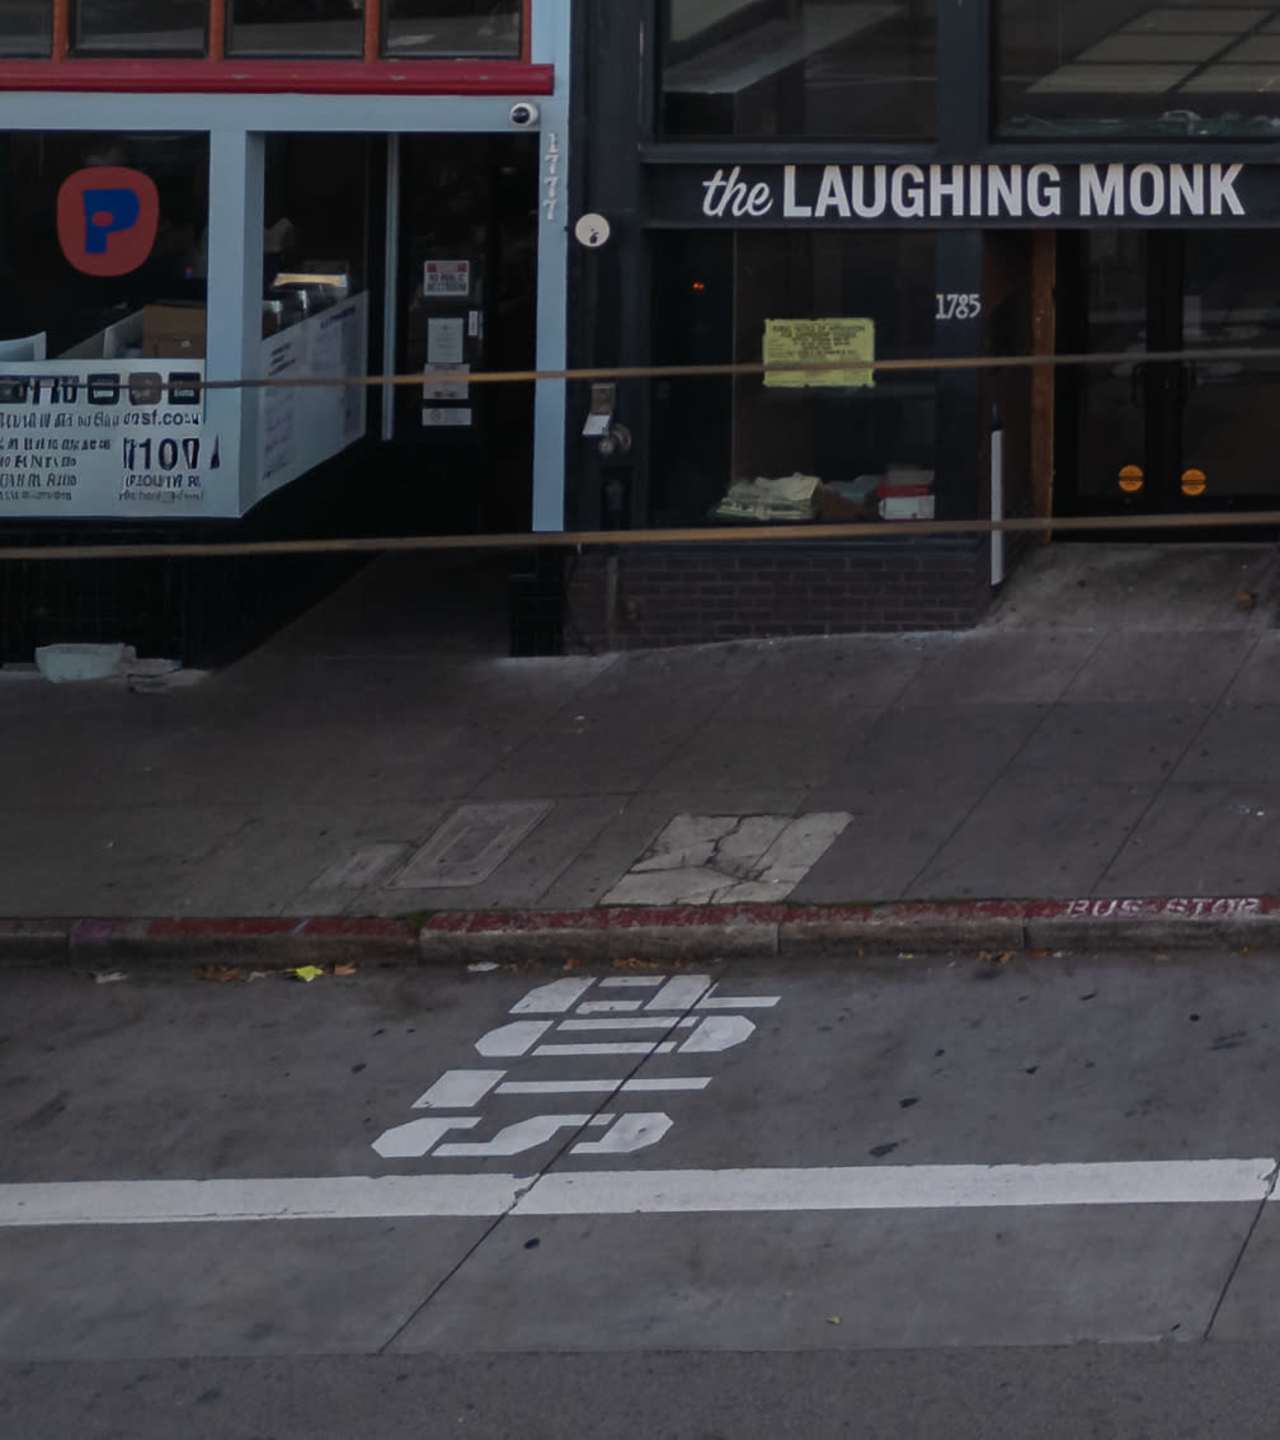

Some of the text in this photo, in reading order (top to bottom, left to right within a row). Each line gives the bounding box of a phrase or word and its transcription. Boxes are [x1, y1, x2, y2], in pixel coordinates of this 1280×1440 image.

[702, 164, 1246, 218] the LAUGHING MONK
[81, 188, 141, 254] P
[935, 292, 981, 320] 1785
[1064, 899, 1144, 918] BUS
[1165, 897, 1261, 917] STOP
